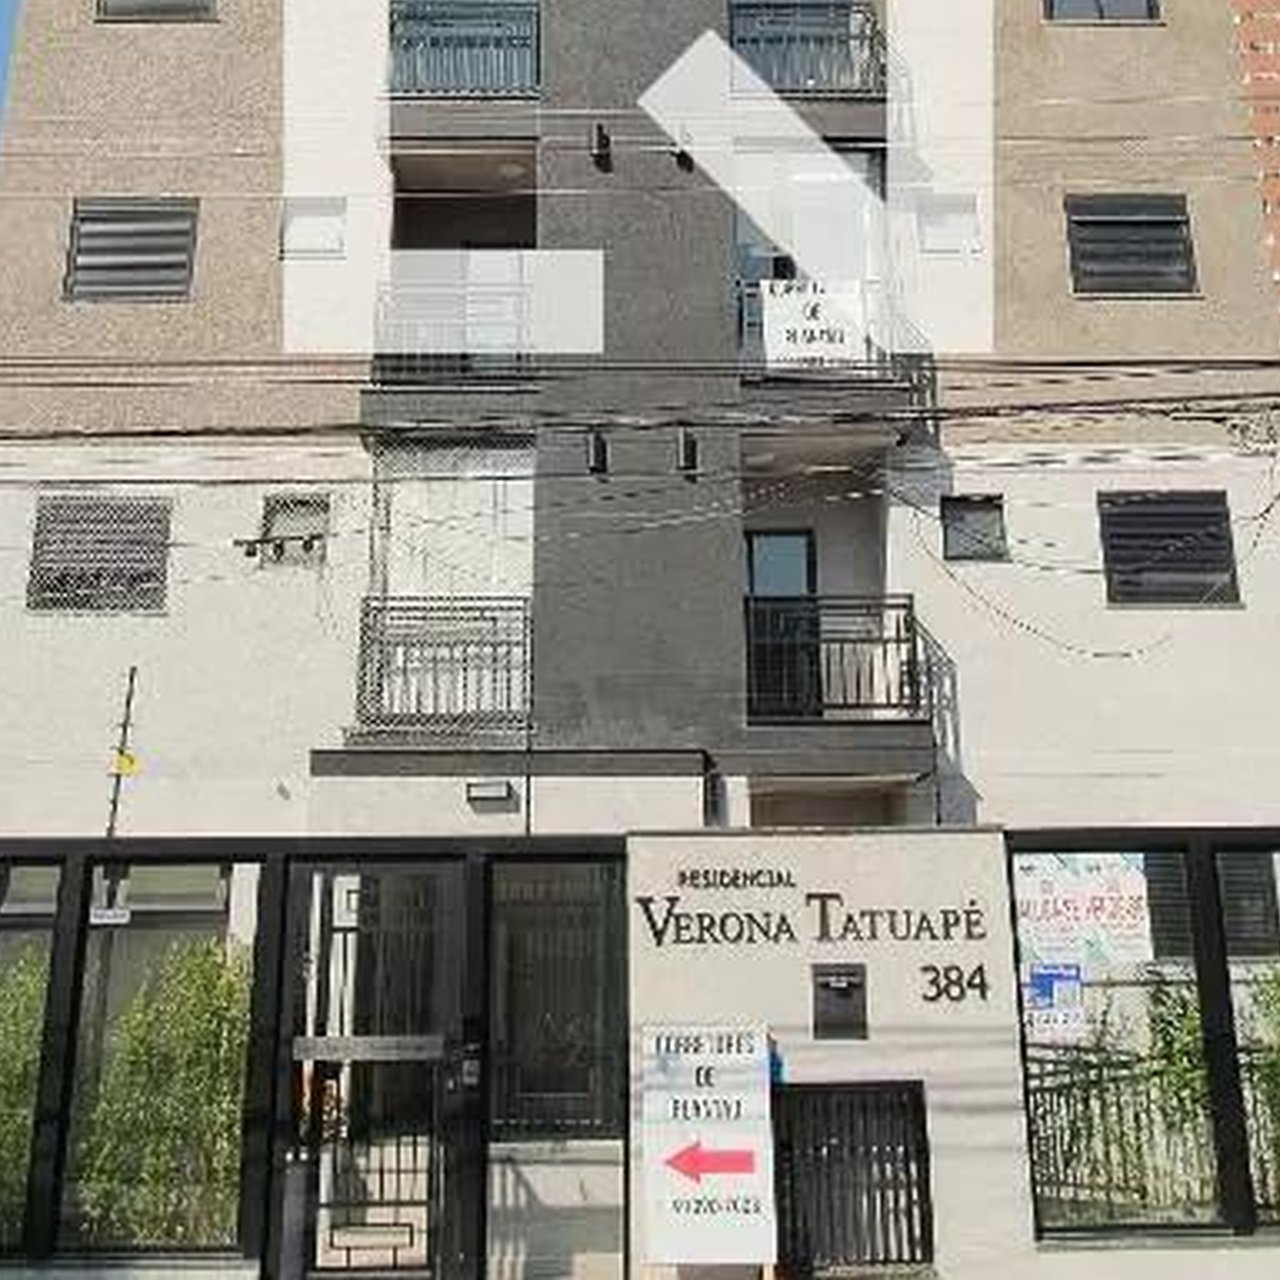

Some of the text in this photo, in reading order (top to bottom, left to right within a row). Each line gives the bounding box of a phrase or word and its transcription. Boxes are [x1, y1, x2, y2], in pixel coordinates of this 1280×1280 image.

[678, 869, 797, 889] RESIDENCIAL
[634, 895, 798, 947] VERONA
[805, 892, 987, 943] TATUAPÉ
[920, 964, 989, 1002] 384
